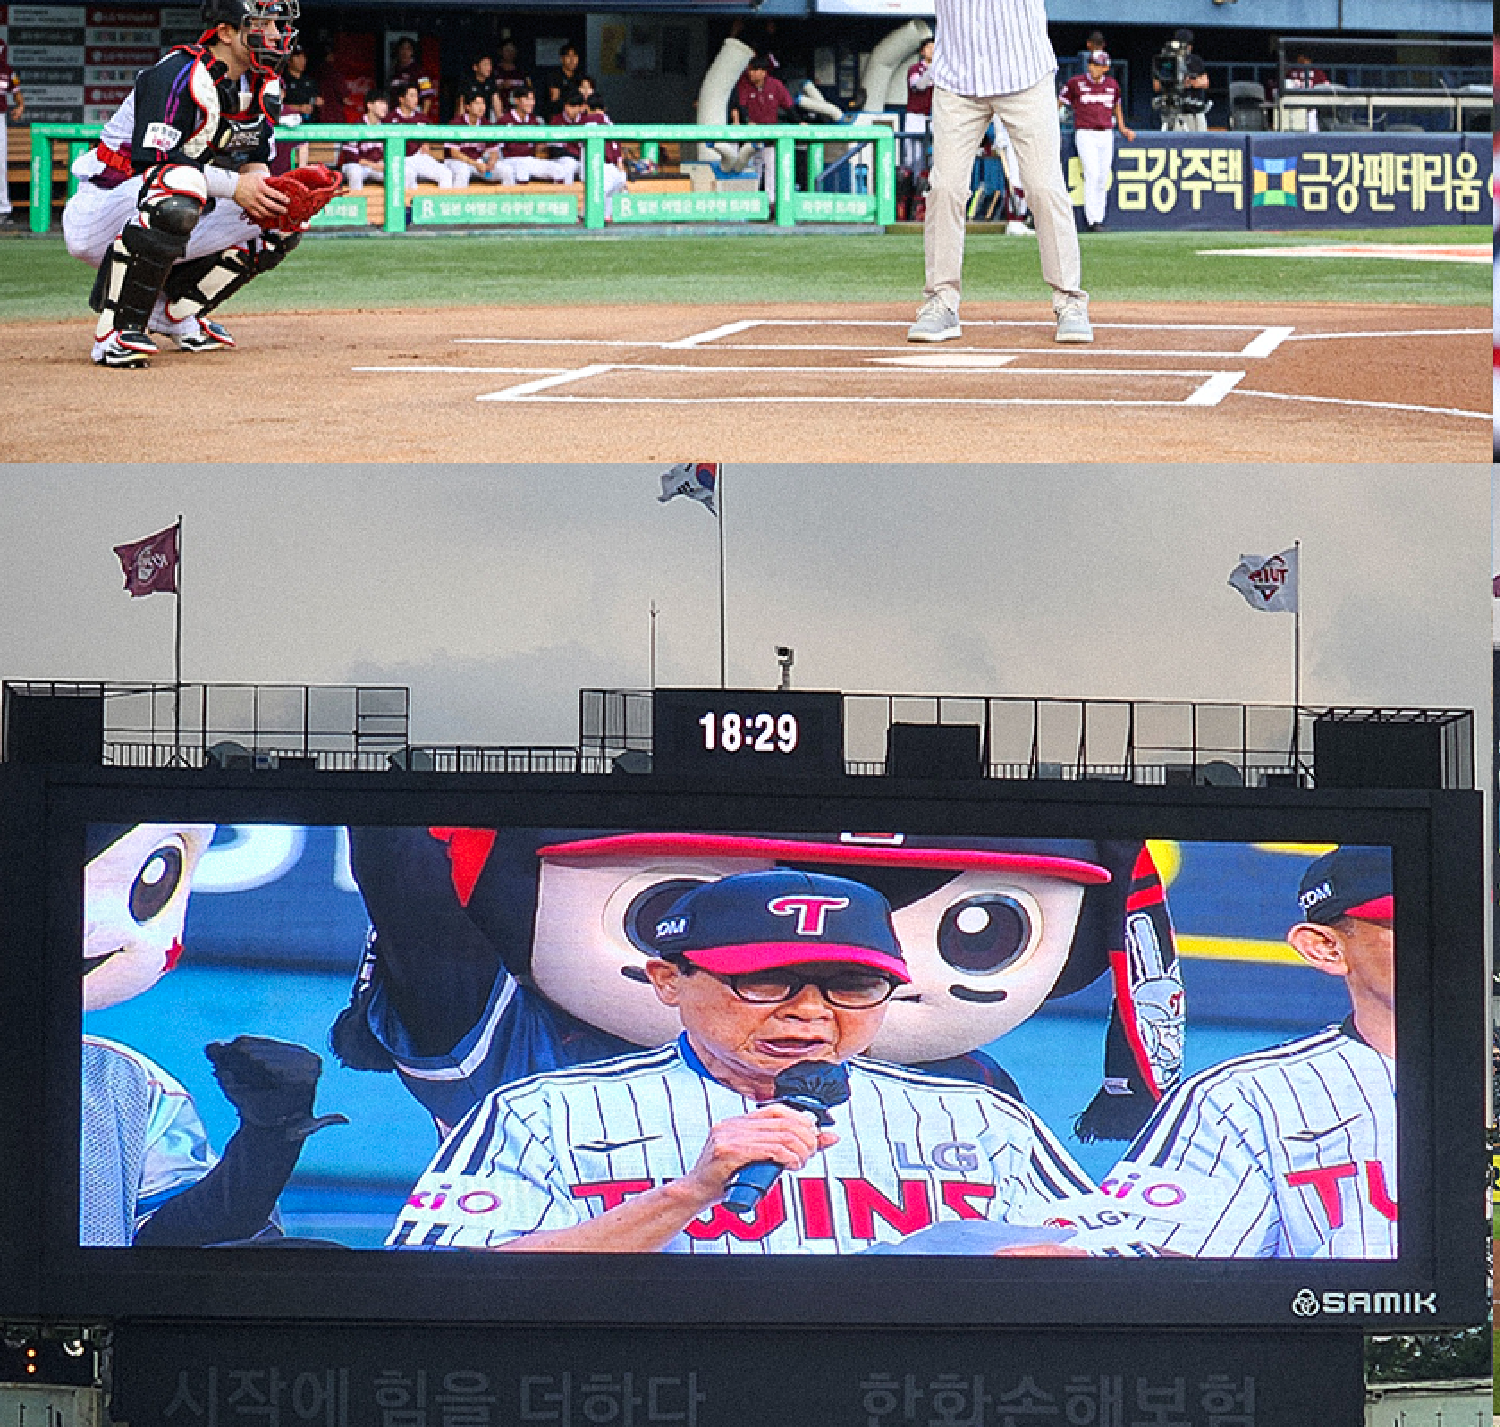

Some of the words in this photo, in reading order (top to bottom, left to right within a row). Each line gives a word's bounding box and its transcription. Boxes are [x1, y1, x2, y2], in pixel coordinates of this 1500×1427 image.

[1117, 148, 1244, 213] 금강주택
[1297, 151, 1483, 214] 금강펜테리움
[699, 712, 798, 752] 18:29
[767, 895, 851, 936] T
[894, 1141, 979, 1172] LG
[1078, 1210, 1123, 1230] LG
[1322, 1291, 1438, 1315] SAMIK
[163, 1367, 351, 1427] 시작에
[375, 1367, 498, 1427] 힘을
[519, 1371, 707, 1427] 더하다
[859, 1370, 1256, 1427] 한화손해보험
